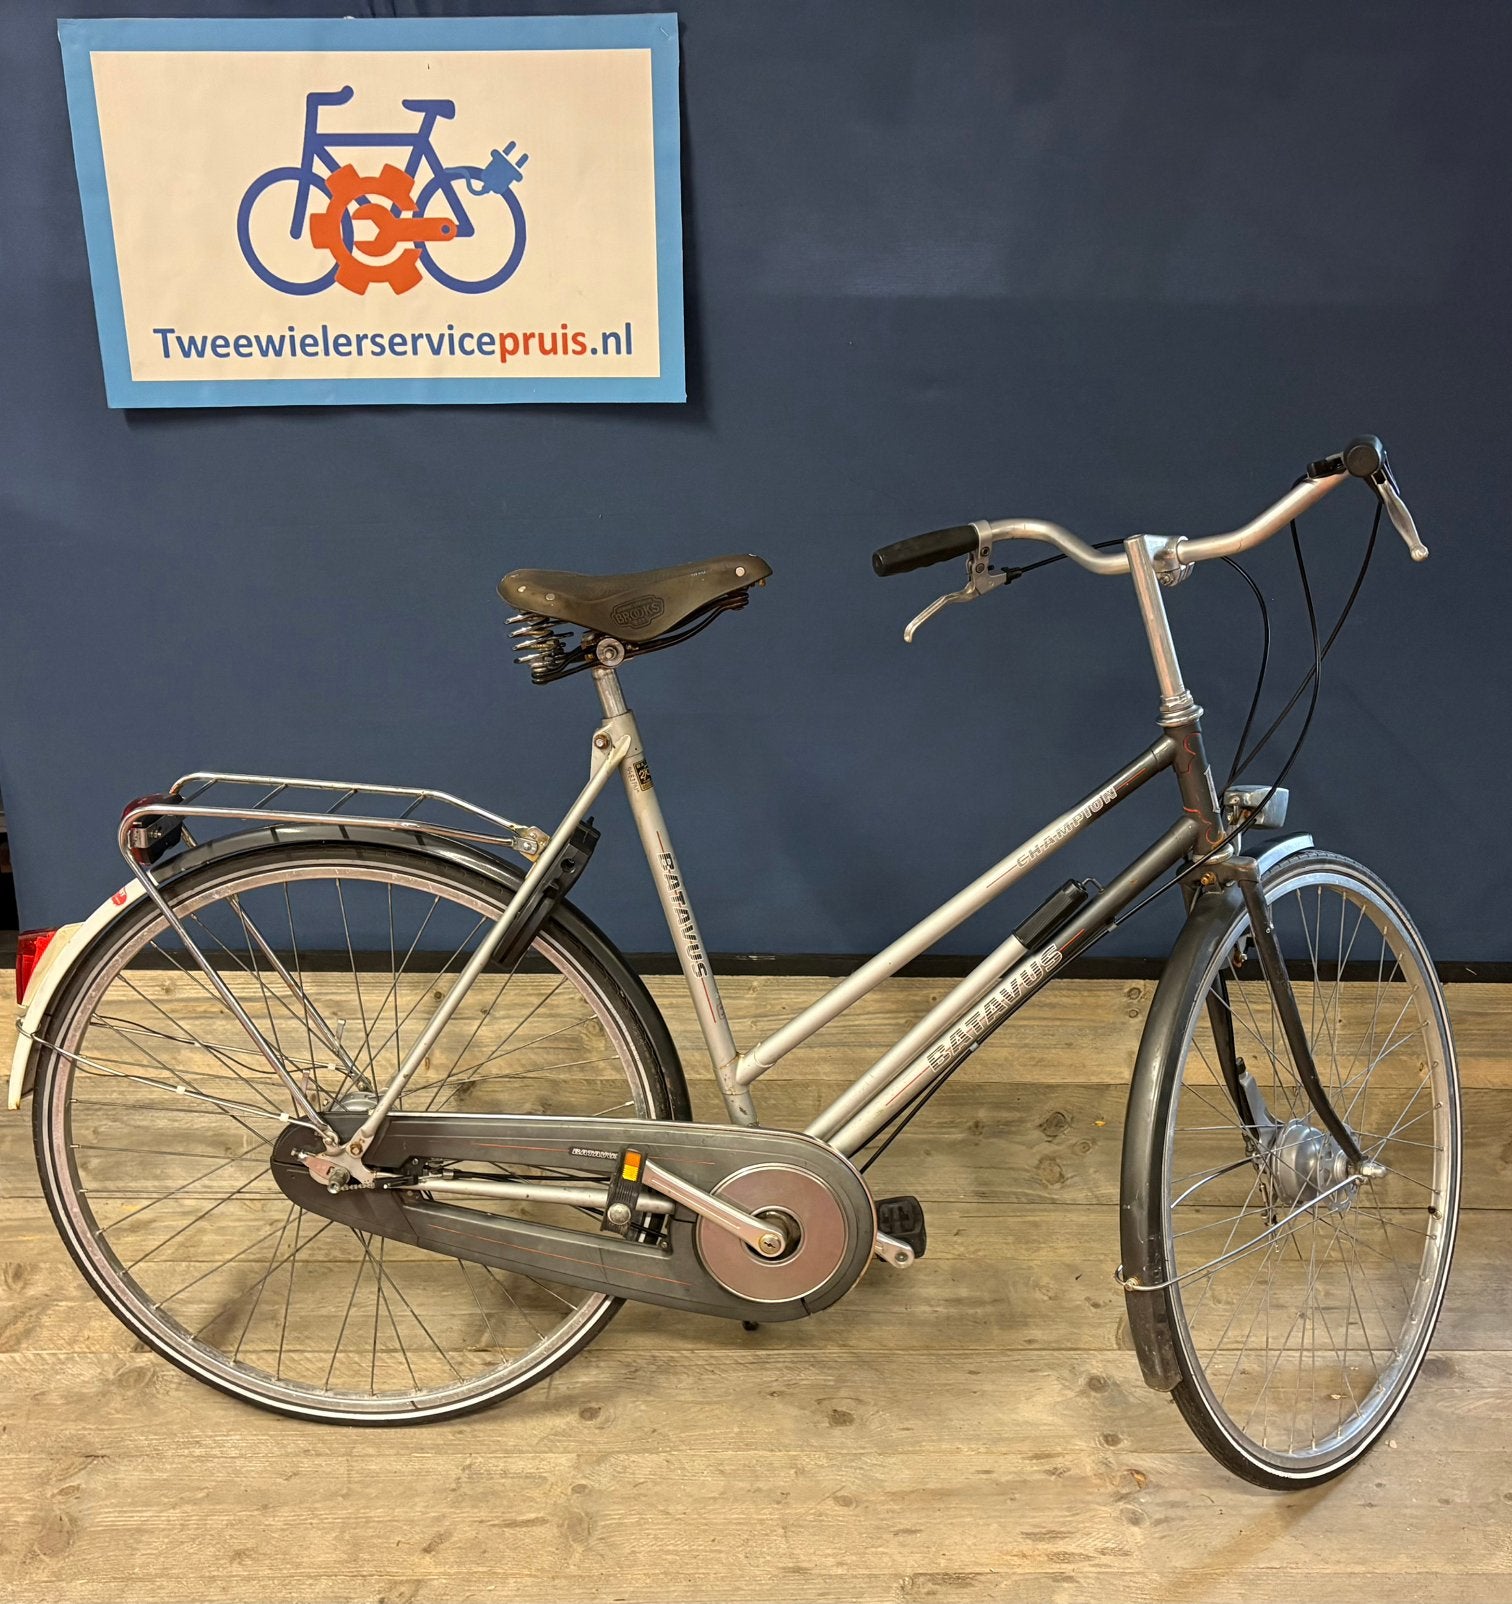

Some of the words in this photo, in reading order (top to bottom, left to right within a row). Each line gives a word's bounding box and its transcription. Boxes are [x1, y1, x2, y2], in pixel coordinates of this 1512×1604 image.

[152, 322, 633, 363] Tweewielerservicepruis.nl
[614, 602, 661, 625] BROOKS
[1016, 785, 1118, 868] CHAMPION
[657, 851, 708, 979] BATAVUS
[926, 943, 1063, 1073] BATAVUS
